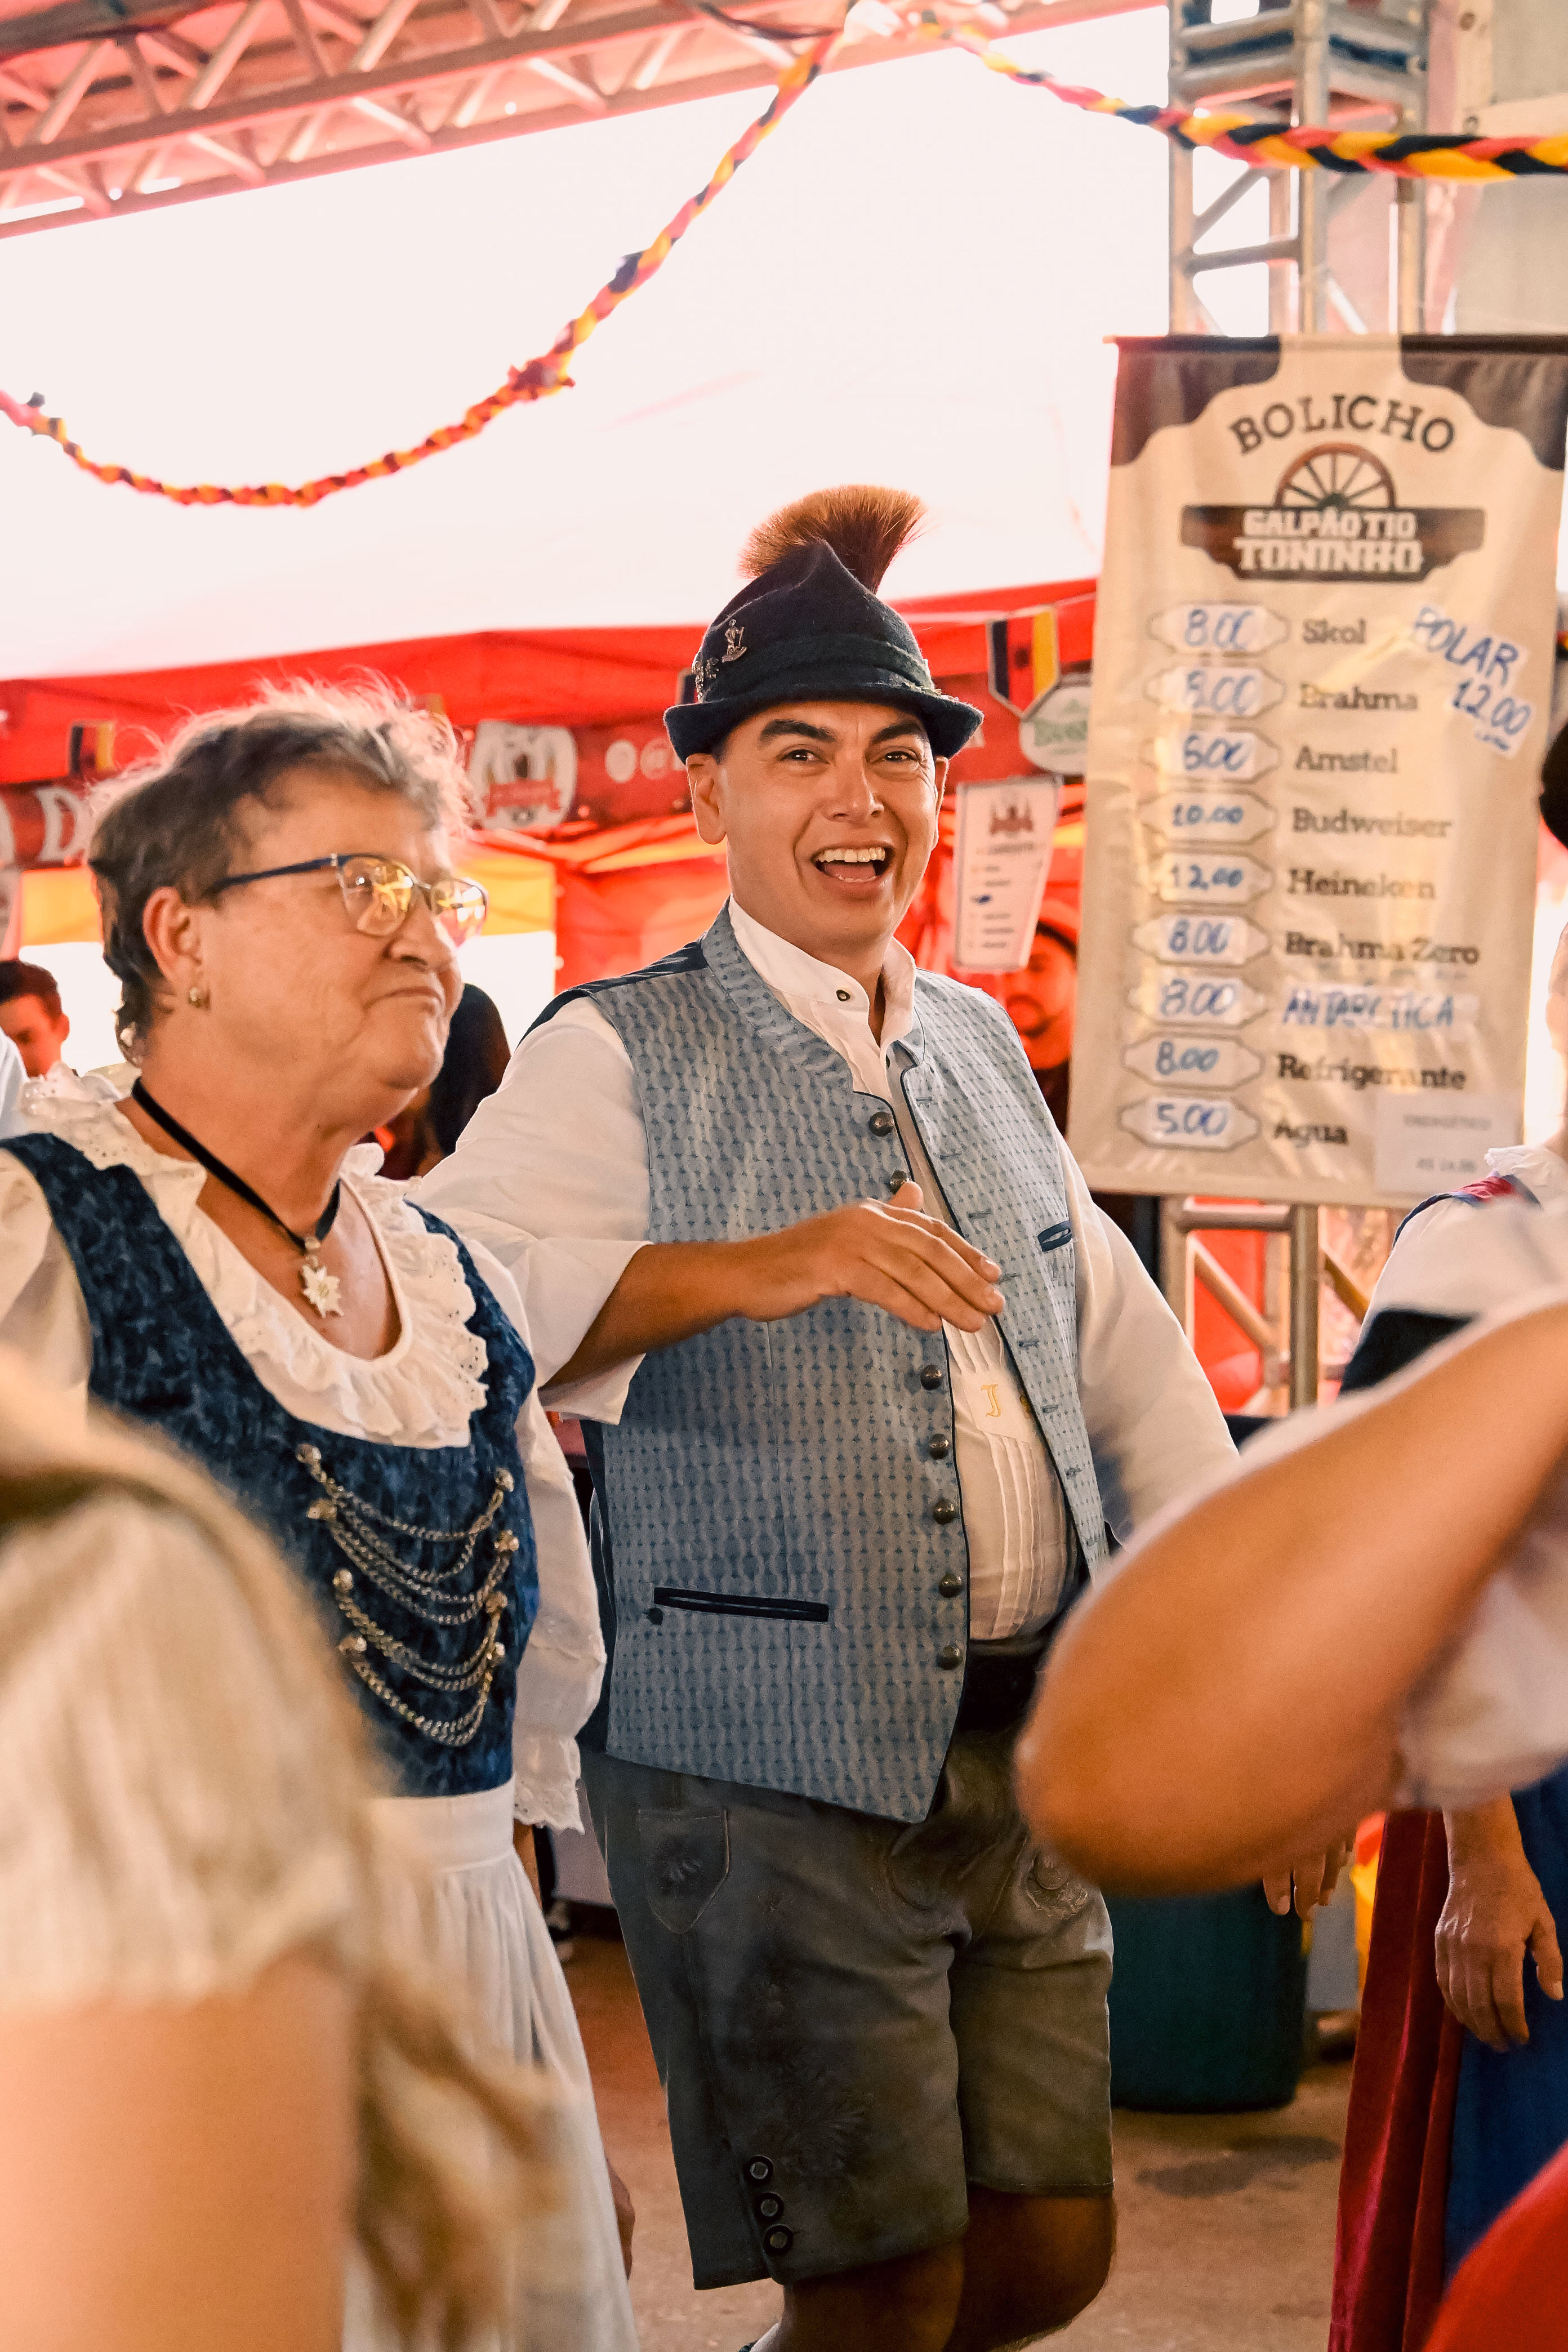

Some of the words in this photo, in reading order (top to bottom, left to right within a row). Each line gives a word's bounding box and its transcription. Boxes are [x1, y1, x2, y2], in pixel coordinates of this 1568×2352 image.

[1229, 394, 1455, 455] BOLICHO
[1363, 511, 1417, 540] TIO
[1233, 537, 1423, 573] TONINHO
[1302, 618, 1366, 645] Skol
[1414, 606, 1520, 686] POLAR
[1298, 683, 1418, 711] Brahma
[1295, 745, 1398, 774] Amstel
[1293, 807, 1452, 838] Budweiser
[1286, 868, 1435, 899] Heineken
